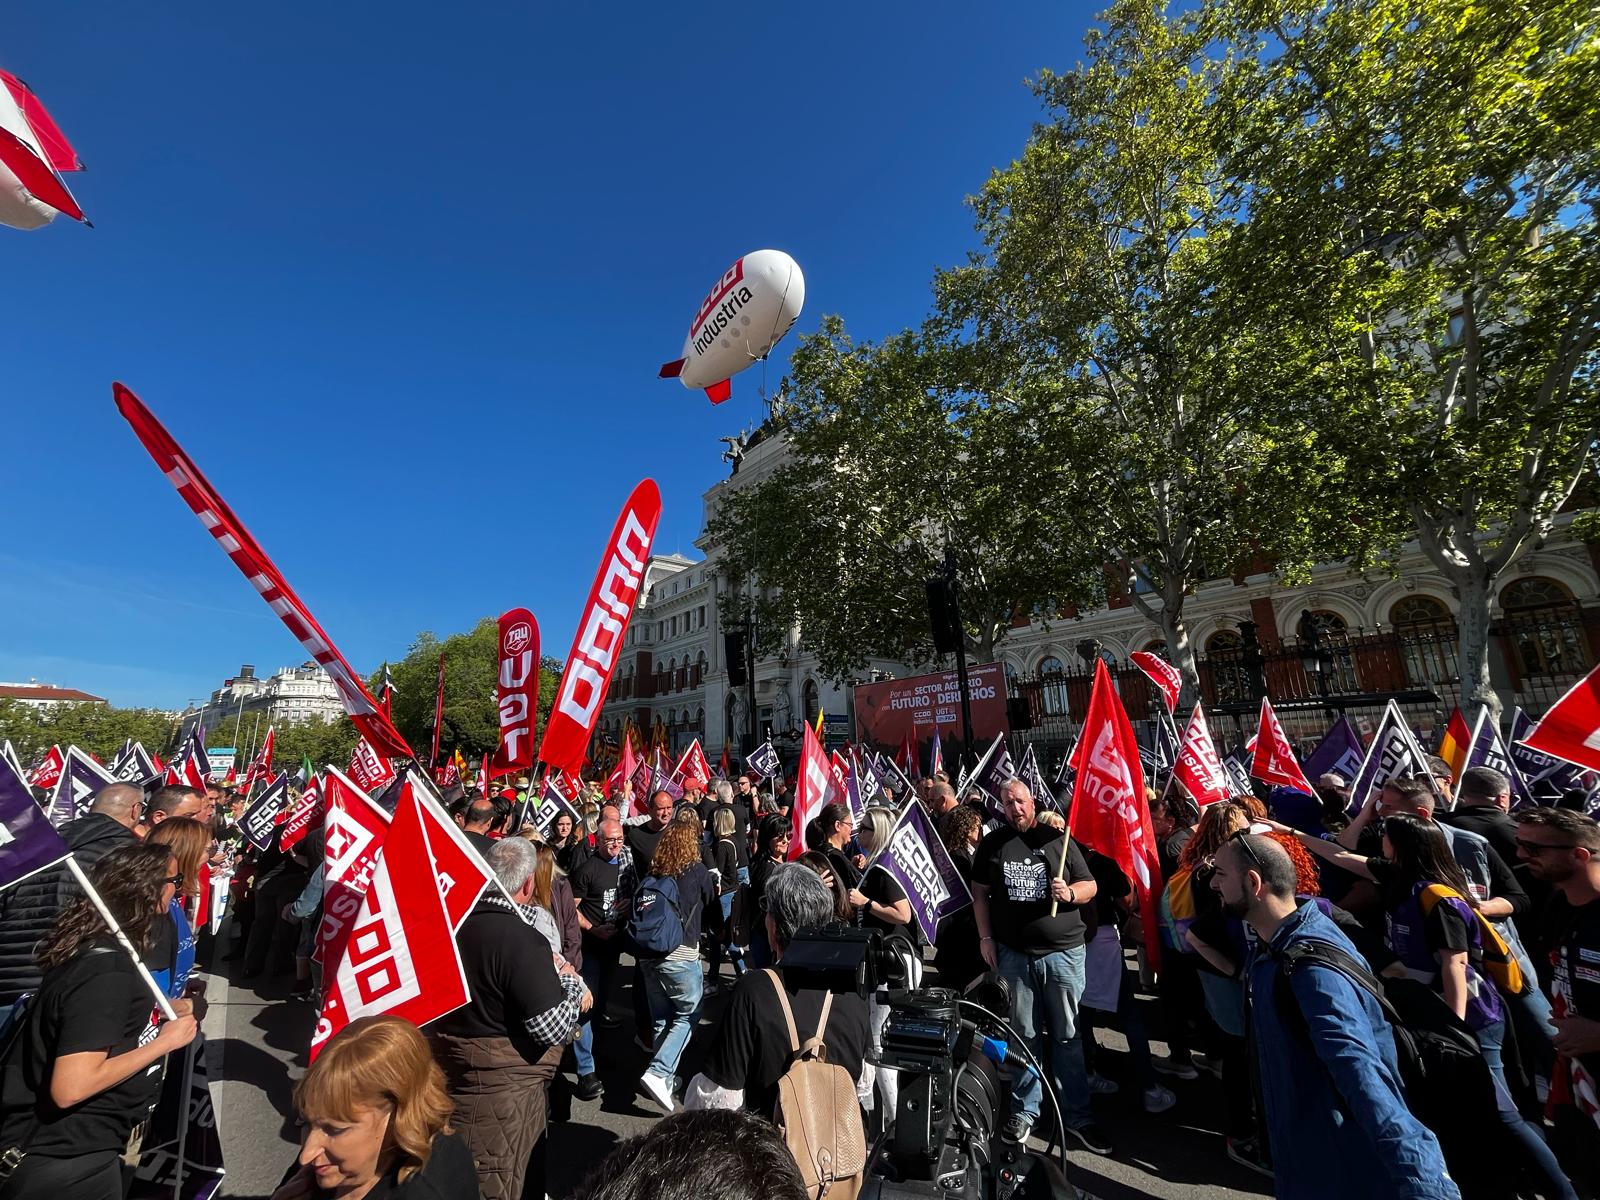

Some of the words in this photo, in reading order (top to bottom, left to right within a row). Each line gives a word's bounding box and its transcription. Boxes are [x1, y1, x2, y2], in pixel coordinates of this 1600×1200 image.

[692, 285, 753, 356] industria
[890, 690, 901, 700] Por
[902, 690, 912, 698] un
[914, 683, 942, 695] SECTOR
[944, 677, 982, 691] AGRIO
[891, 695, 930, 710] FUTURO
[937, 686, 996, 705] DERHOS
[1007, 888, 1046, 899] DERECHOS
[1011, 878, 1041, 888] FUTURO
